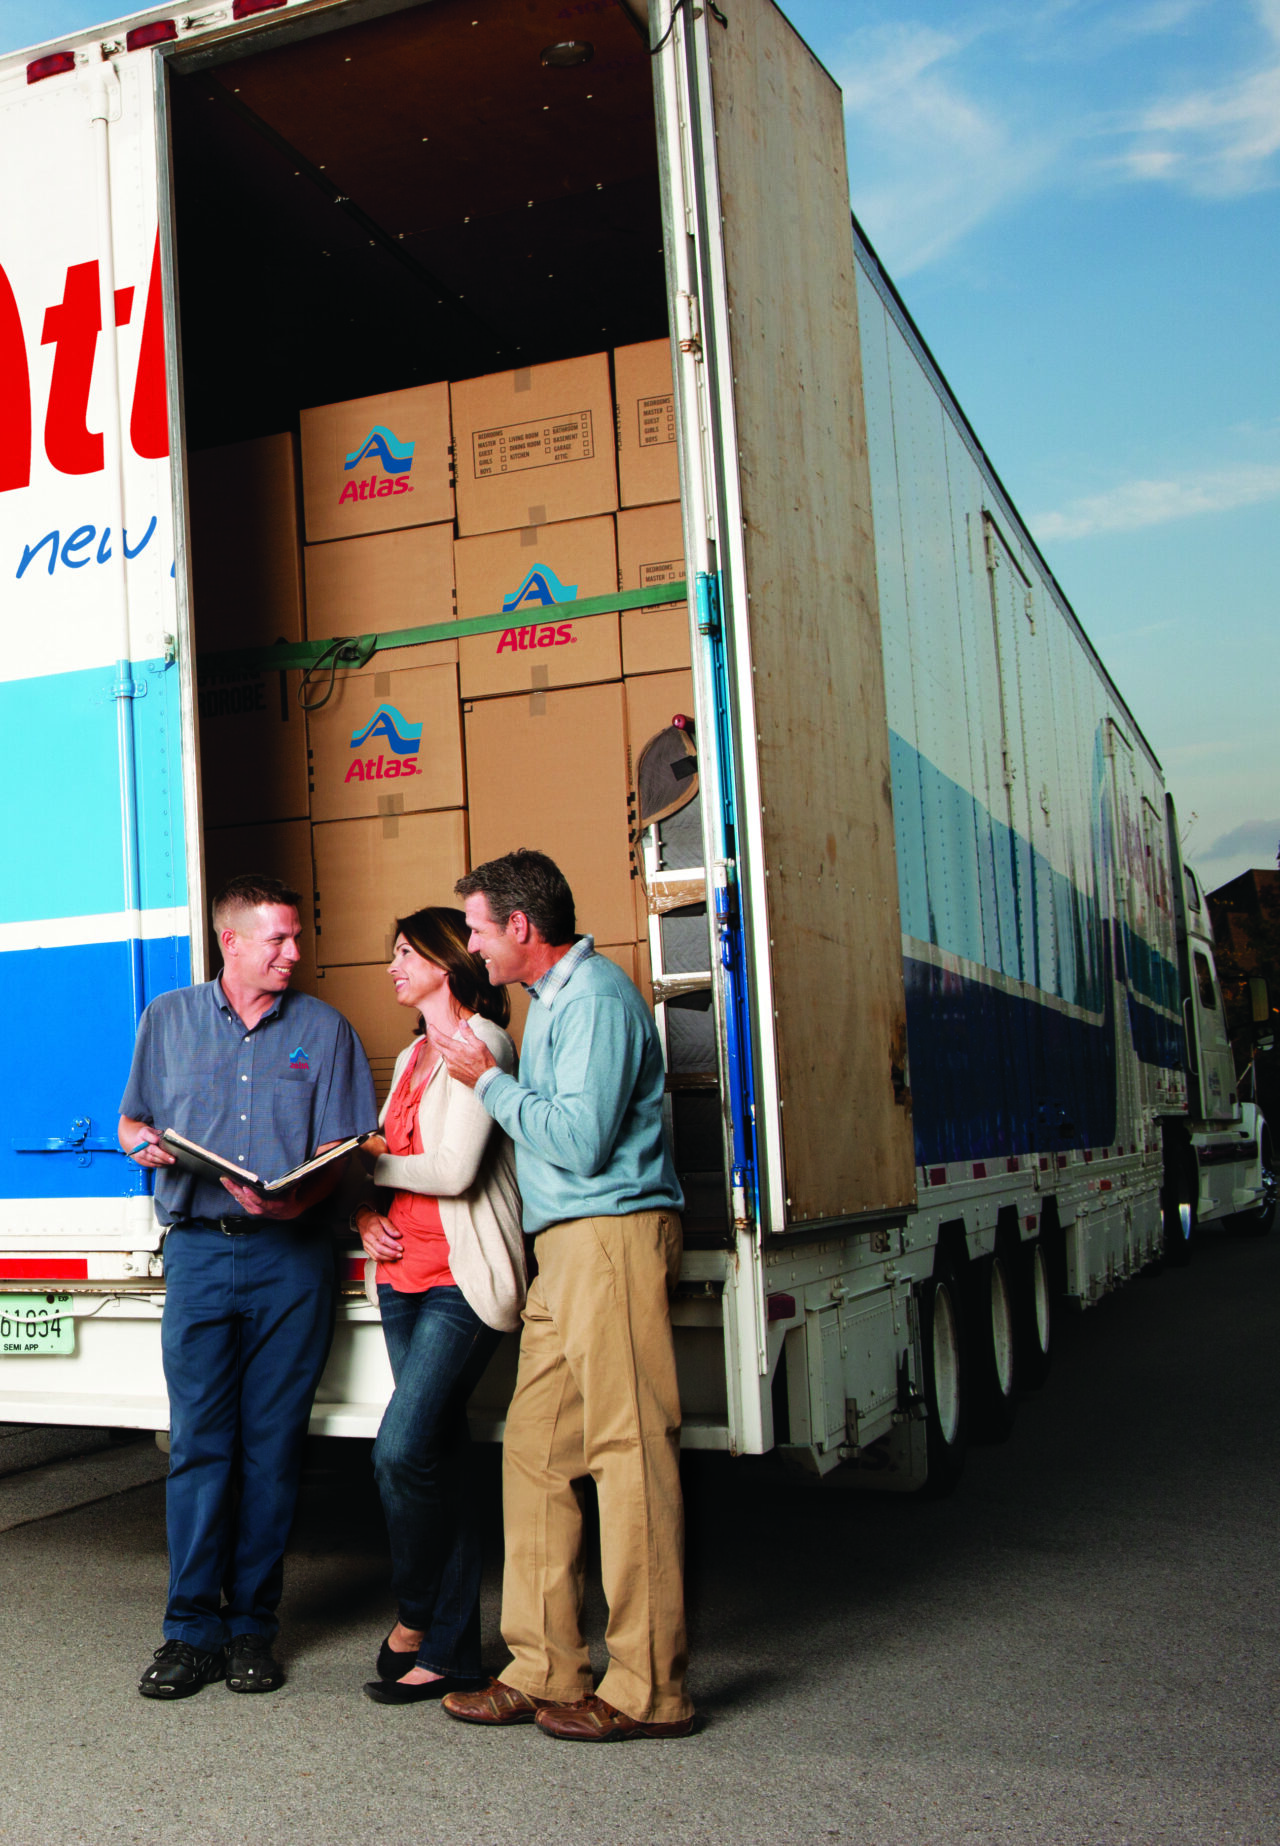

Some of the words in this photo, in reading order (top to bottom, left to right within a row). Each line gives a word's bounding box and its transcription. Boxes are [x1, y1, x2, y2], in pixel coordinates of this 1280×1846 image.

[478, 430, 503, 440] BEDROOMS
[508, 434, 524, 443] LIVING
[525, 432, 539, 440] ROOM
[552, 433, 578, 443] BASEMENT
[478, 440, 496, 449] MASTER
[526, 440, 541, 448] ROOM
[553, 443, 572, 452] GARAGE
[478, 449, 493, 457] GUEST
[509, 451, 530, 460] KITCHEN
[554, 453, 568, 461] ATTIC
[16, 516, 157, 580] new
[645, 574, 665, 582] MASTER
[3, 1343, 22, 1351] SEMI
[24, 1343, 39, 1351] APP
